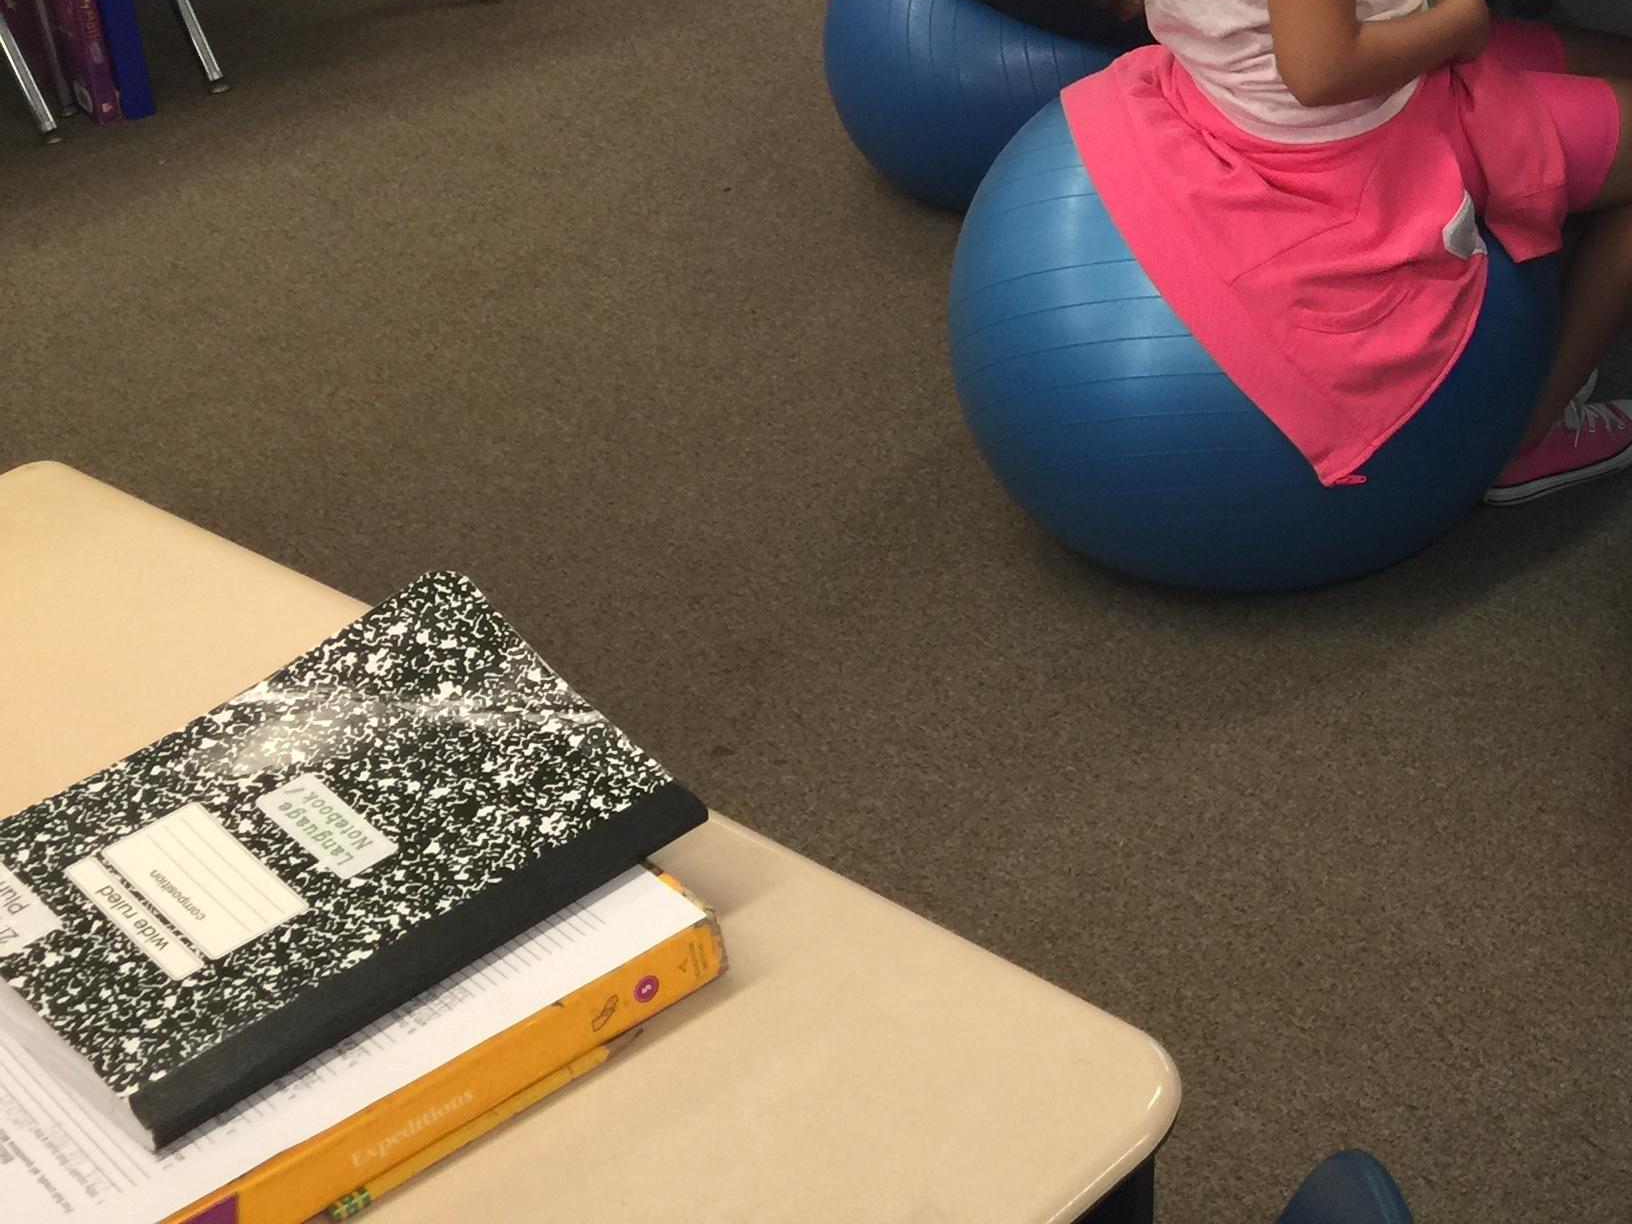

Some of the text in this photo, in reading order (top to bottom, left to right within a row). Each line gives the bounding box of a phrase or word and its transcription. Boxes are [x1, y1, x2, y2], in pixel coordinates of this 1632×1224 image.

[277, 800, 354, 867] Language
[302, 790, 374, 852] Notebook
[97, 883, 170, 952] wide ruled
[148, 868, 207, 922] composition
[350, 1088, 475, 1168] Expeditions
